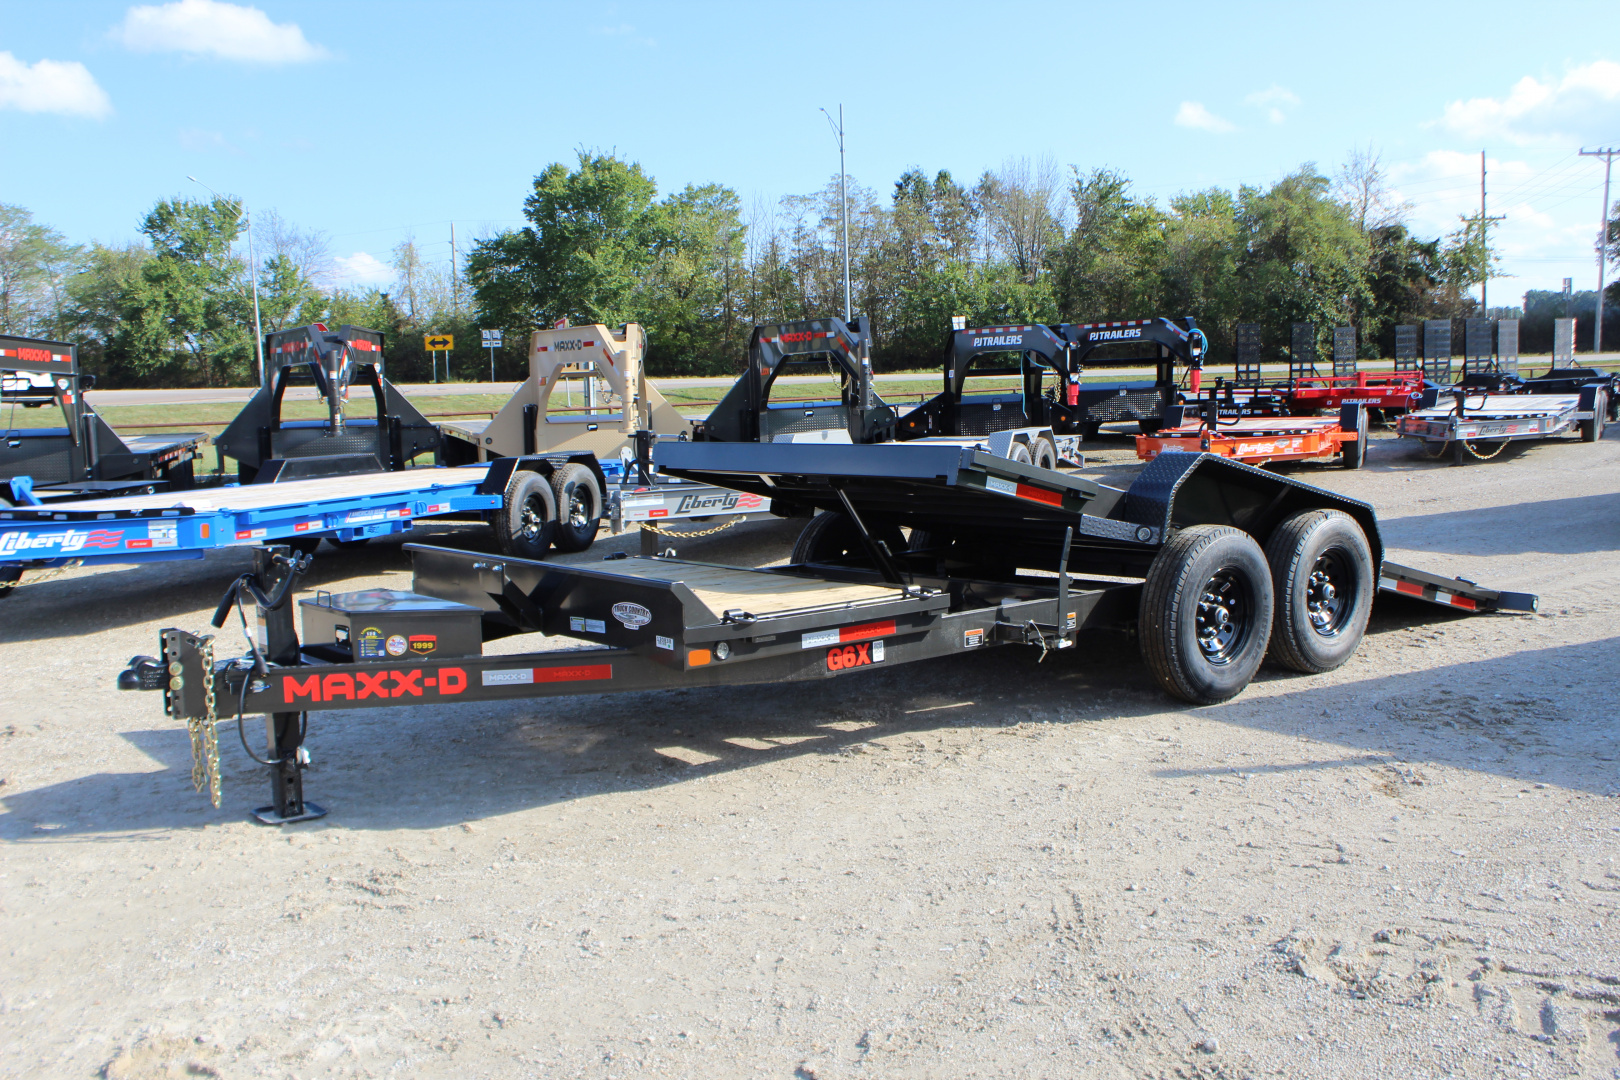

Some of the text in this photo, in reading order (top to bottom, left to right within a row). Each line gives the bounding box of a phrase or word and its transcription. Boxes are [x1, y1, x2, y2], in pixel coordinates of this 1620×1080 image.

[780, 330, 812, 344] MAXX-D
[972, 334, 1023, 347] PJ TRAILERS
[1089, 328, 1142, 341] PJ TRAILERS
[553, 339, 582, 352] MAXX-D
[17, 347, 51, 362] MAXX-D
[675, 492, 740, 515] Liberty
[0, 529, 88, 556] Liberty
[614, 604, 649, 617] TRUCK COUNTRY
[827, 643, 871, 671] G6X
[488, 670, 592, 682] MAXX-D MAXX-D
[283, 667, 467, 703] MAXX-D
